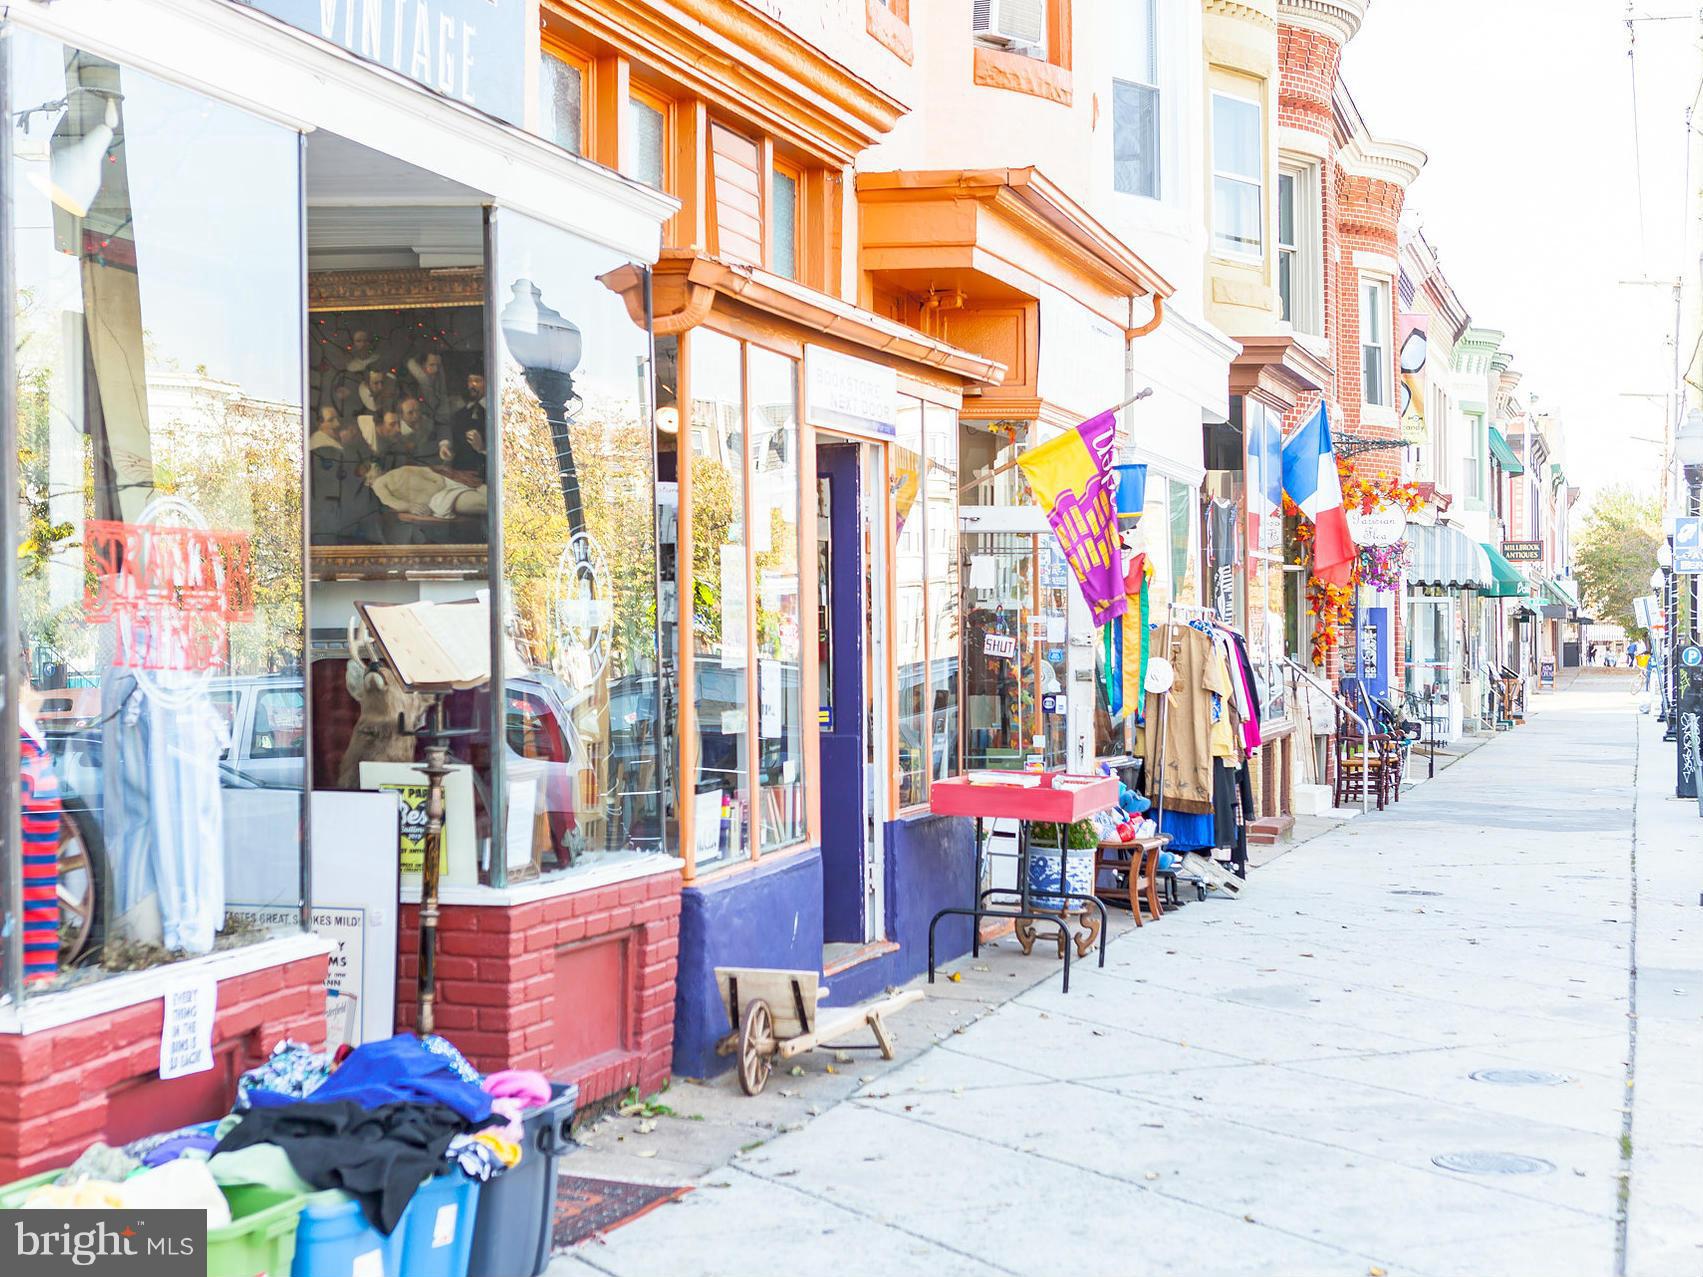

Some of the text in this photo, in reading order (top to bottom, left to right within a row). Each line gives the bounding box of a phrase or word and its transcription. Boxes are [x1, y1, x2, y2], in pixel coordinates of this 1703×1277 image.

[816, 367, 880, 399] BOOKSTORE
[831, 391, 890, 418] NEXT DOOR
[1505, 551, 1539, 559] ANTIQUES
[985, 638, 1013, 653] SHUT
[293, 914, 331, 926] SKES
[173, 1005, 197, 1021] THING
